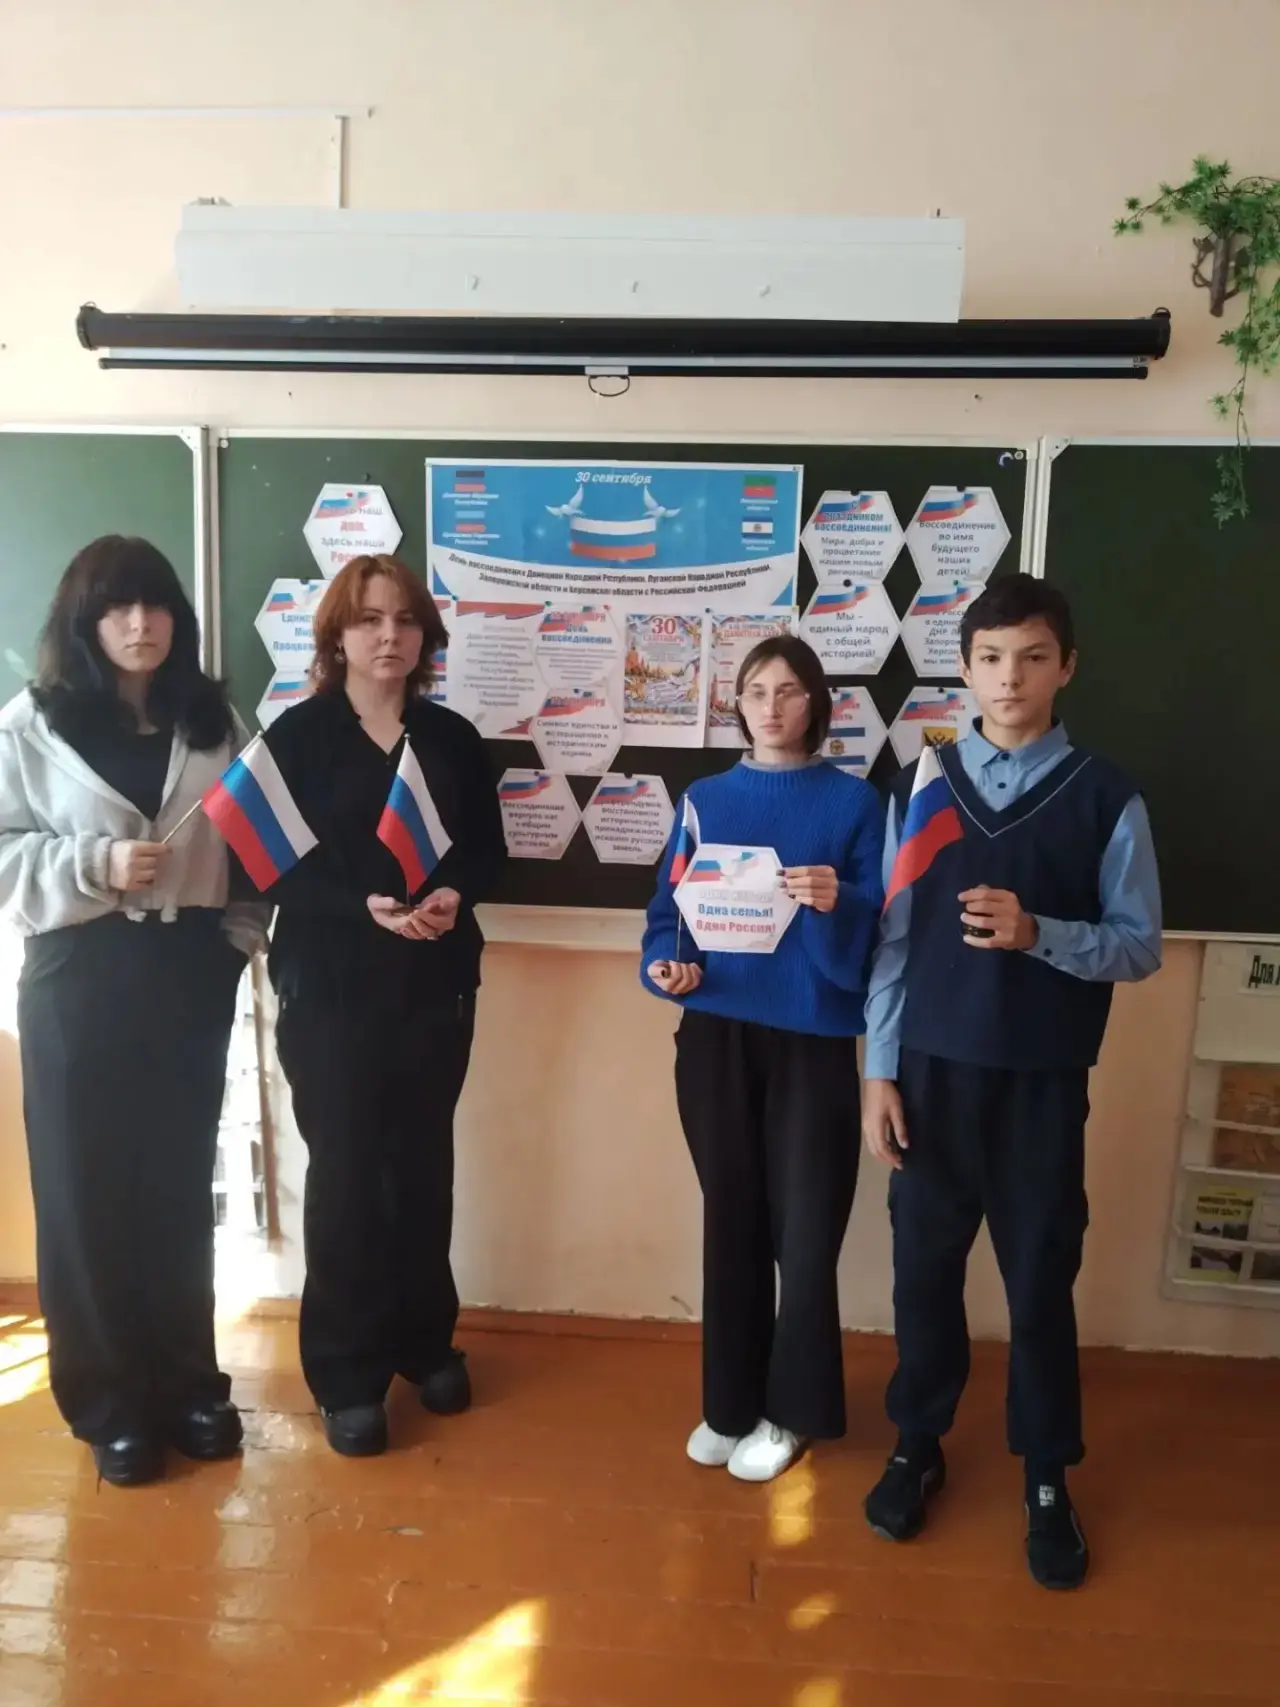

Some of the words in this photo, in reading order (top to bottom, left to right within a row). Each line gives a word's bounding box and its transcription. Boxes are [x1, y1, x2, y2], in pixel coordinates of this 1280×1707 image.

[574, 471, 590, 482] 30
[591, 472, 652, 486] сентября
[952, 533, 975, 541] имя
[931, 543, 980, 554] будущего
[448, 553, 468, 566] День
[835, 612, 855, 621] Мы
[652, 617, 676, 635] 30
[809, 624, 853, 634] единый
[855, 625, 890, 636] народ
[833, 636, 872, 648] общей
[820, 649, 876, 660] историей!
[697, 903, 729, 916] Одна
[730, 906, 774, 919] семья!
[728, 920, 777, 934] Россия!
[1247, 954, 1275, 989] Для
